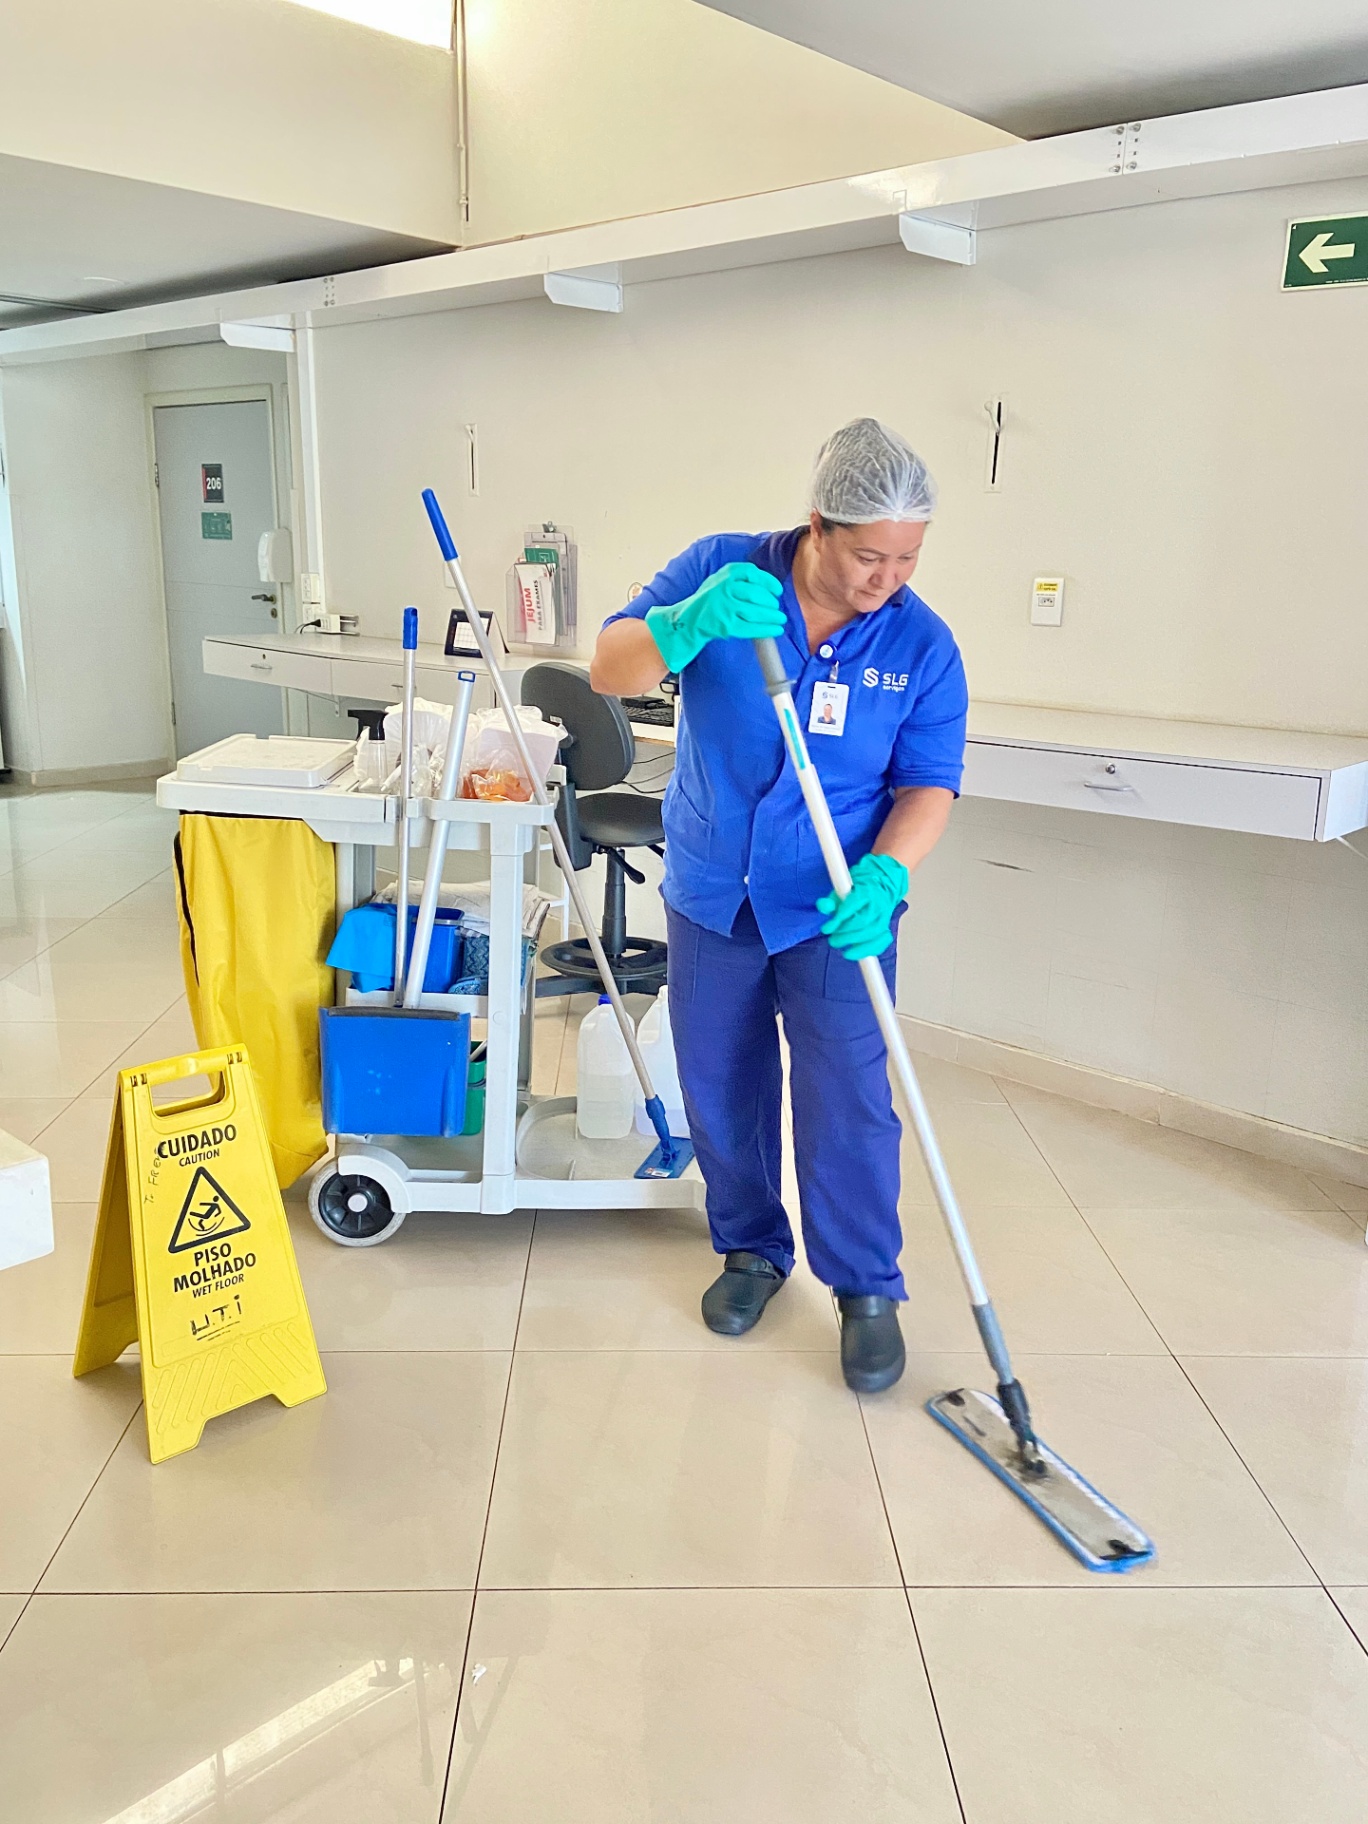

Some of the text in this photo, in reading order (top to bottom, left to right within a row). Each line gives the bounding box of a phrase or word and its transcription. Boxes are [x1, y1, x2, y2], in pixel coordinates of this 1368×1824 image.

[206, 477, 222, 490] 206
[523, 587, 536, 624] JEJUM
[882, 672, 909, 686] SLG
[157, 1124, 237, 1159] CUIDADO
[179, 1148, 220, 1167] CAUTION
[193, 1242, 232, 1267] PISO
[173, 1252, 257, 1293] MOLHADO
[192, 1273, 245, 1299] WET FLOOR
